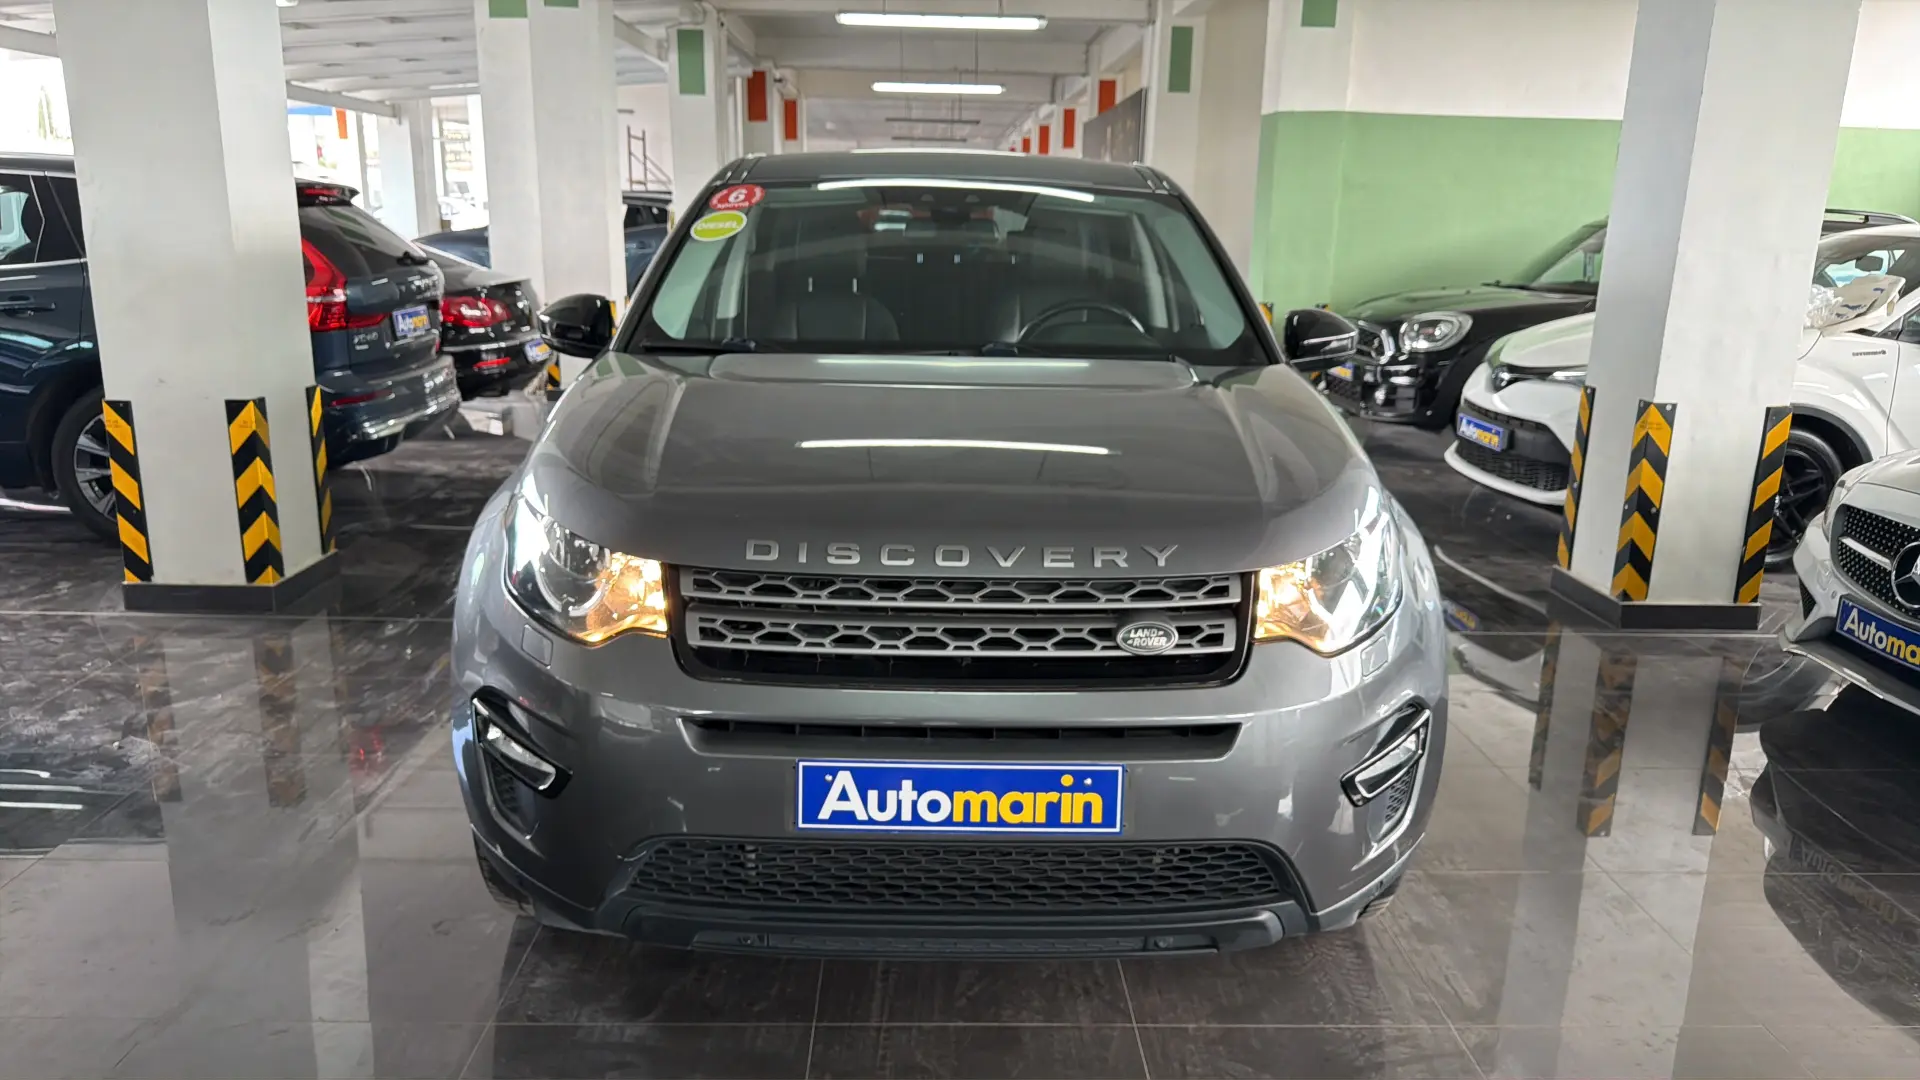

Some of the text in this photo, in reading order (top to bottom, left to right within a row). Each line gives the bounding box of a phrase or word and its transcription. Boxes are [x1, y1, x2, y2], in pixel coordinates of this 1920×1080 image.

[728, 189, 748, 203] 6
[745, 539, 1180, 568] DISCOVERY
[1129, 628, 1158, 637] LAND
[1133, 636, 1168, 647] ROVER
[817, 770, 1103, 824] Automarin
